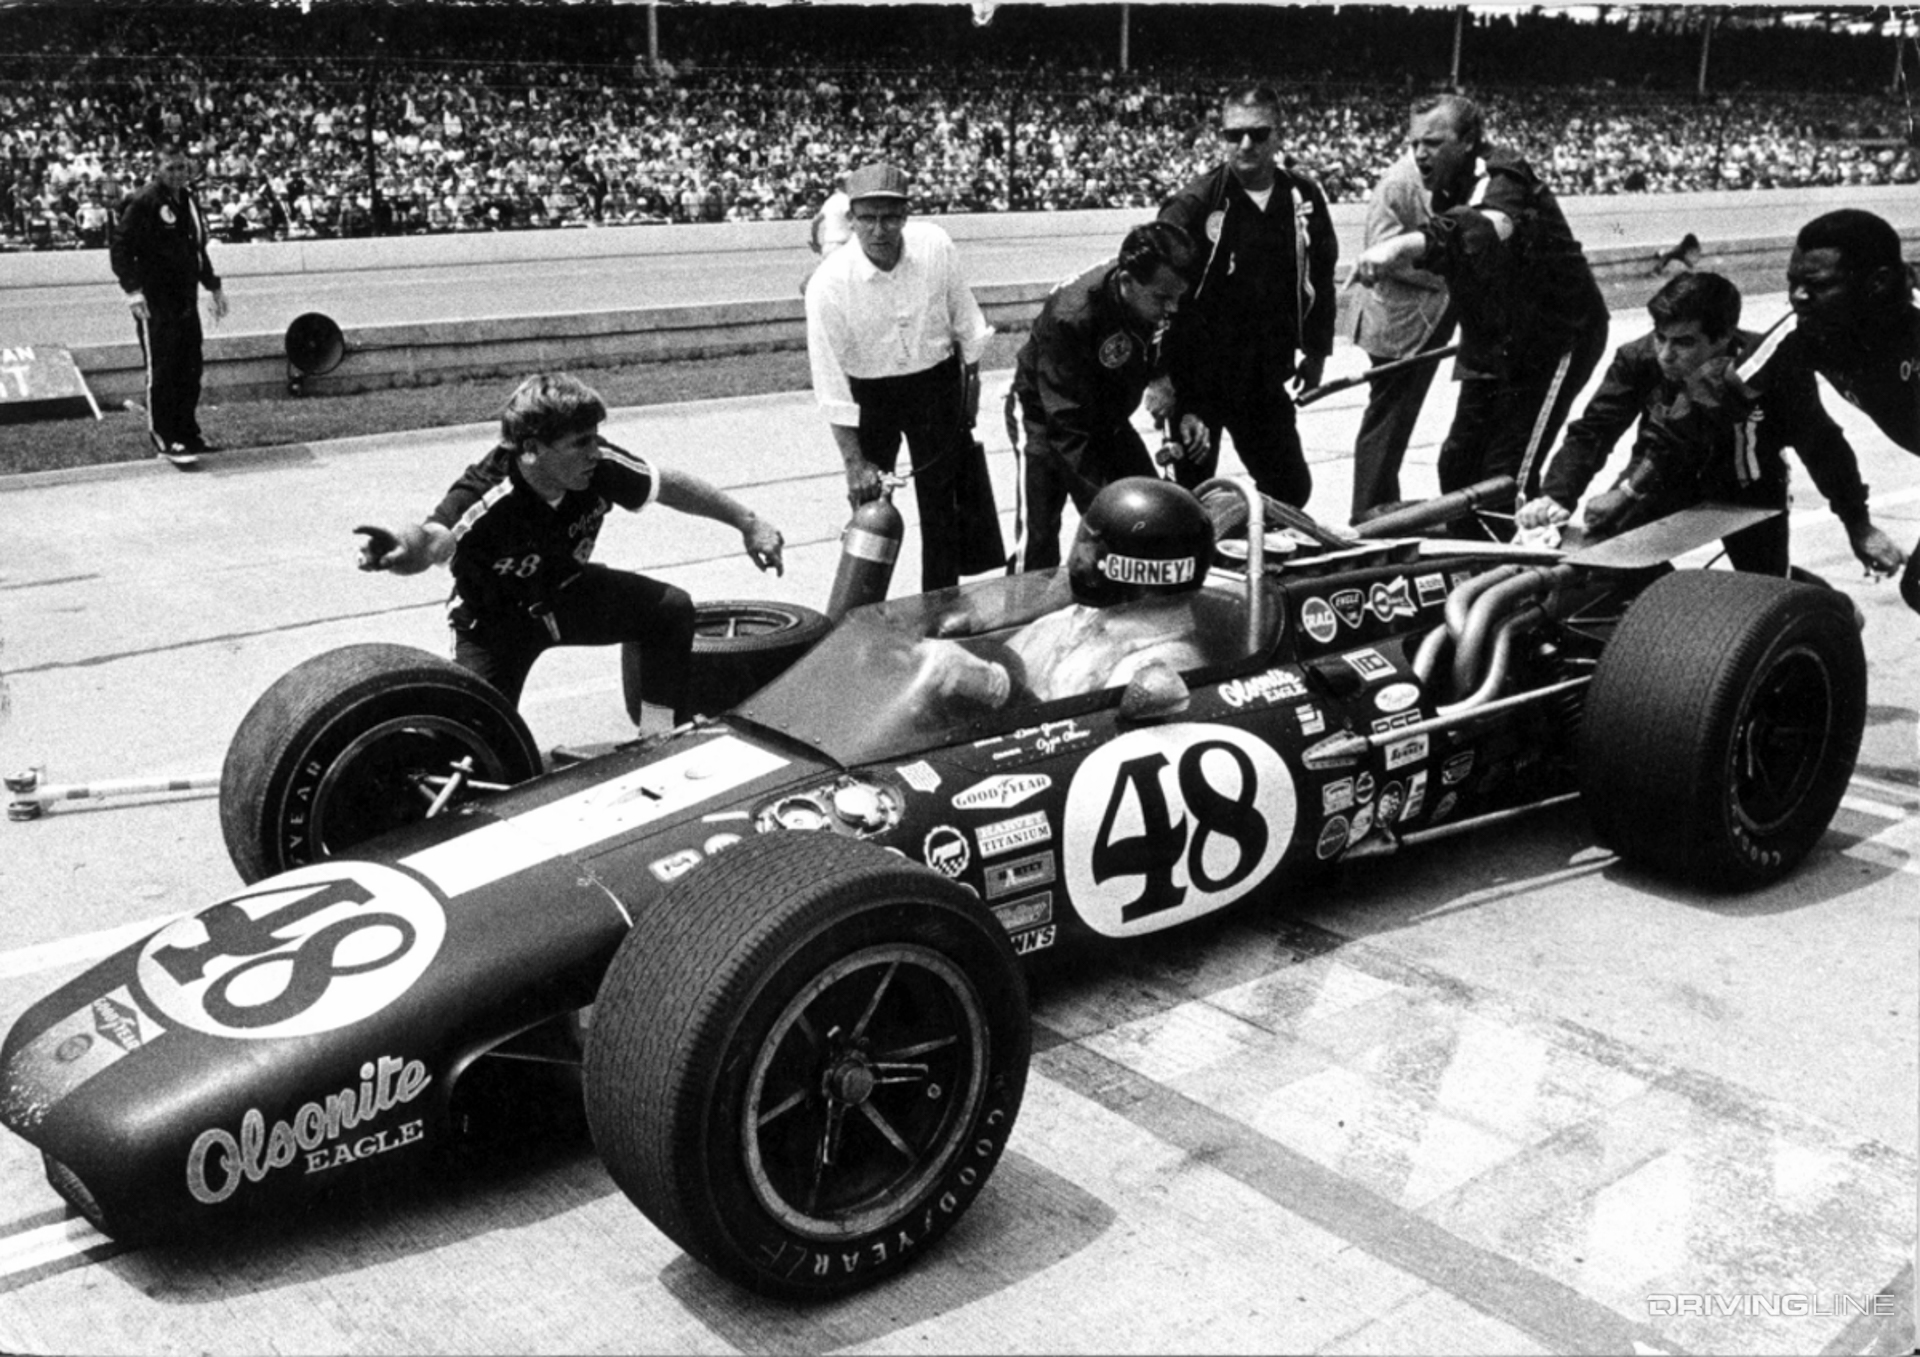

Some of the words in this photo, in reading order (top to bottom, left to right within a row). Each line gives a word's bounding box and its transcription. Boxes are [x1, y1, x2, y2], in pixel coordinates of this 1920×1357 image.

[492, 553, 542, 578] 48
[1107, 556, 1193, 583] GURNEY!
[956, 776, 1047, 807] GOODYEAR
[982, 825, 1049, 852] TITANIUM
[1091, 739, 1269, 924] 48
[150, 877, 416, 1029] 48
[187, 1056, 433, 1204] Olsonite
[304, 1119, 424, 1174] EAGLE
